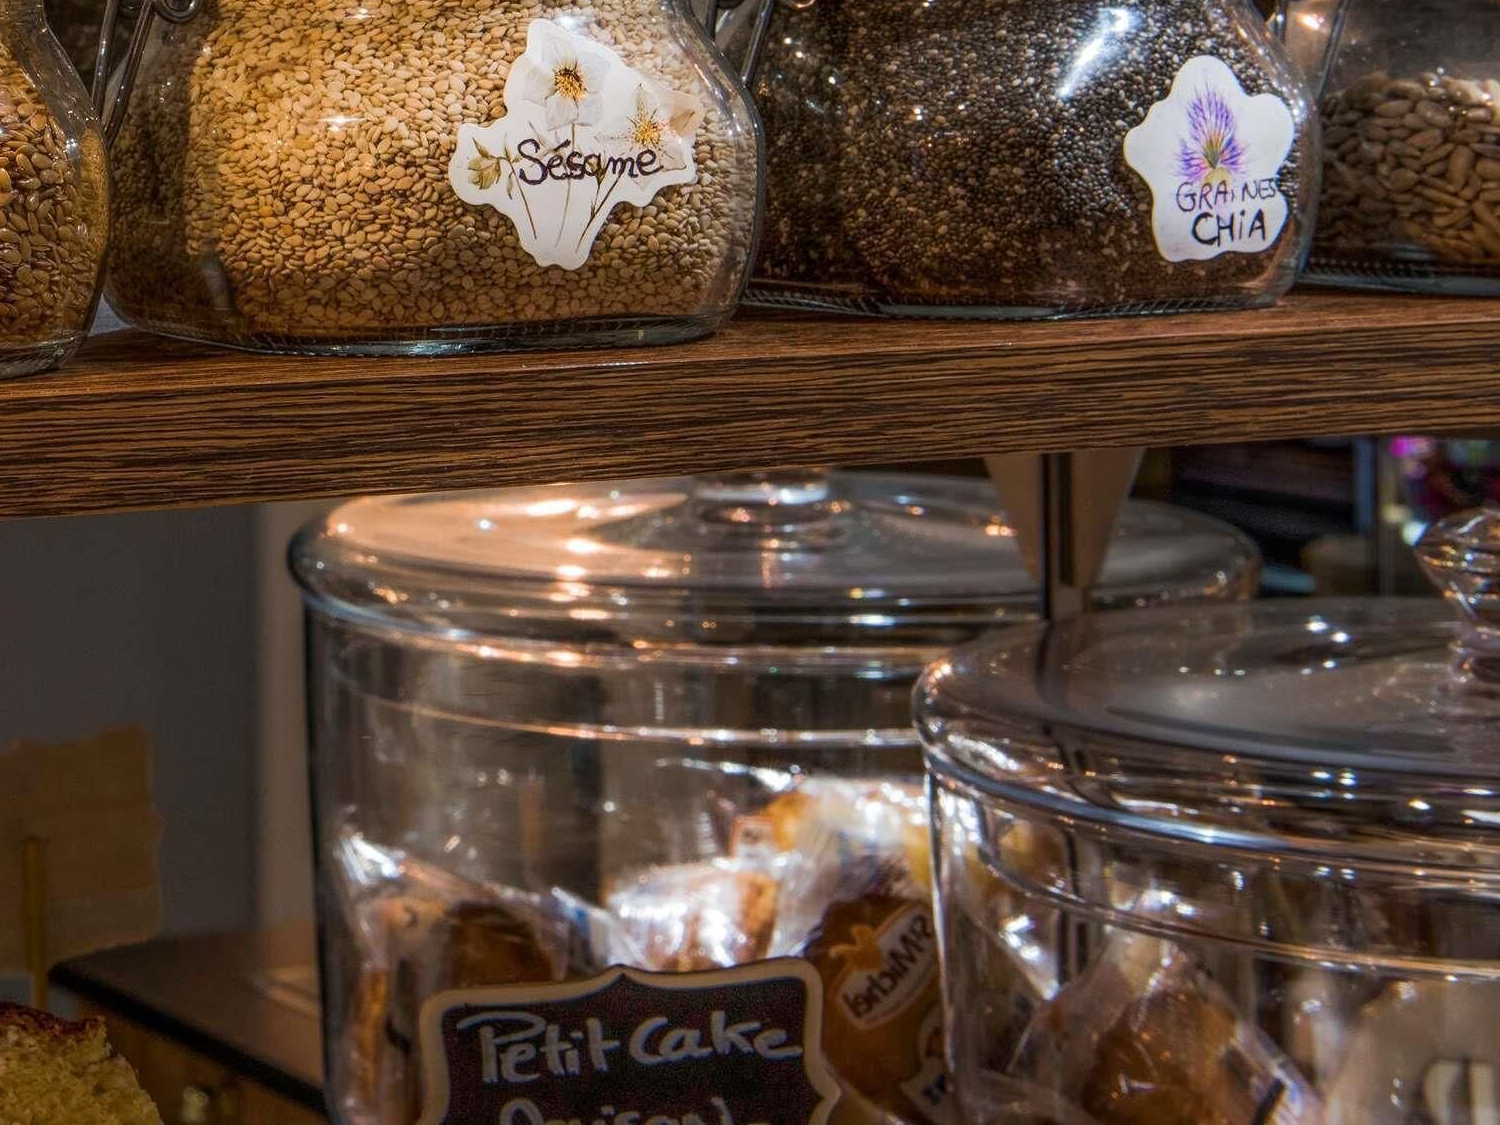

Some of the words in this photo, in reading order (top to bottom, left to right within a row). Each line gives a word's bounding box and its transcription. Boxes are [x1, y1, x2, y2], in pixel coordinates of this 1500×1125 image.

[516, 138, 665, 186] Sésame
[456, 1011, 621, 1084] Petit
[628, 1010, 804, 1066] Cake
